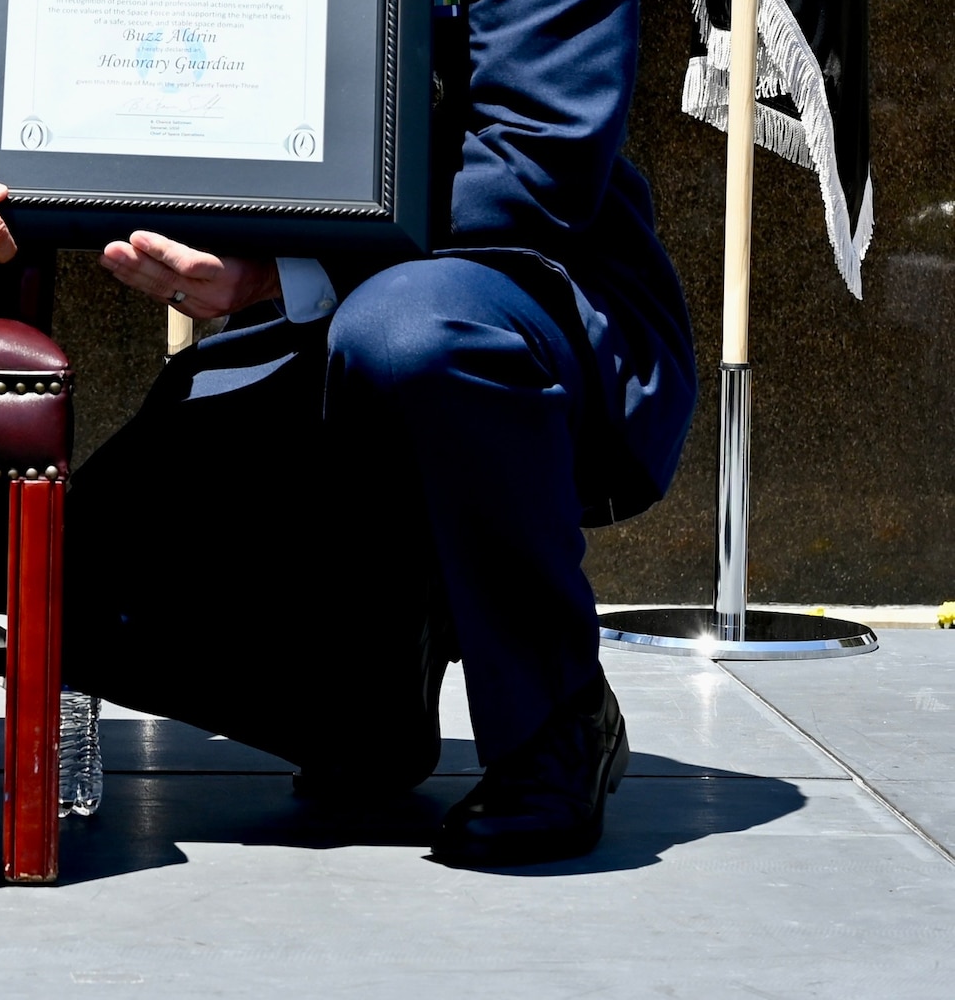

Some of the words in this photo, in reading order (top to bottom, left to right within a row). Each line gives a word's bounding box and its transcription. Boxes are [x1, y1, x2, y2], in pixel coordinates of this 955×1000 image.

[164, 0, 209, 8] professional
[238, 2, 284, 10] exemplifying
[126, 8, 148, 16] Space
[187, 11, 226, 19] supporting
[242, 12, 268, 20] highest
[122, 28, 164, 43] Buzz
[166, 28, 217, 44] Aldrin
[97, 53, 170, 74] Honorary
[174, 55, 245, 74] Guardian
